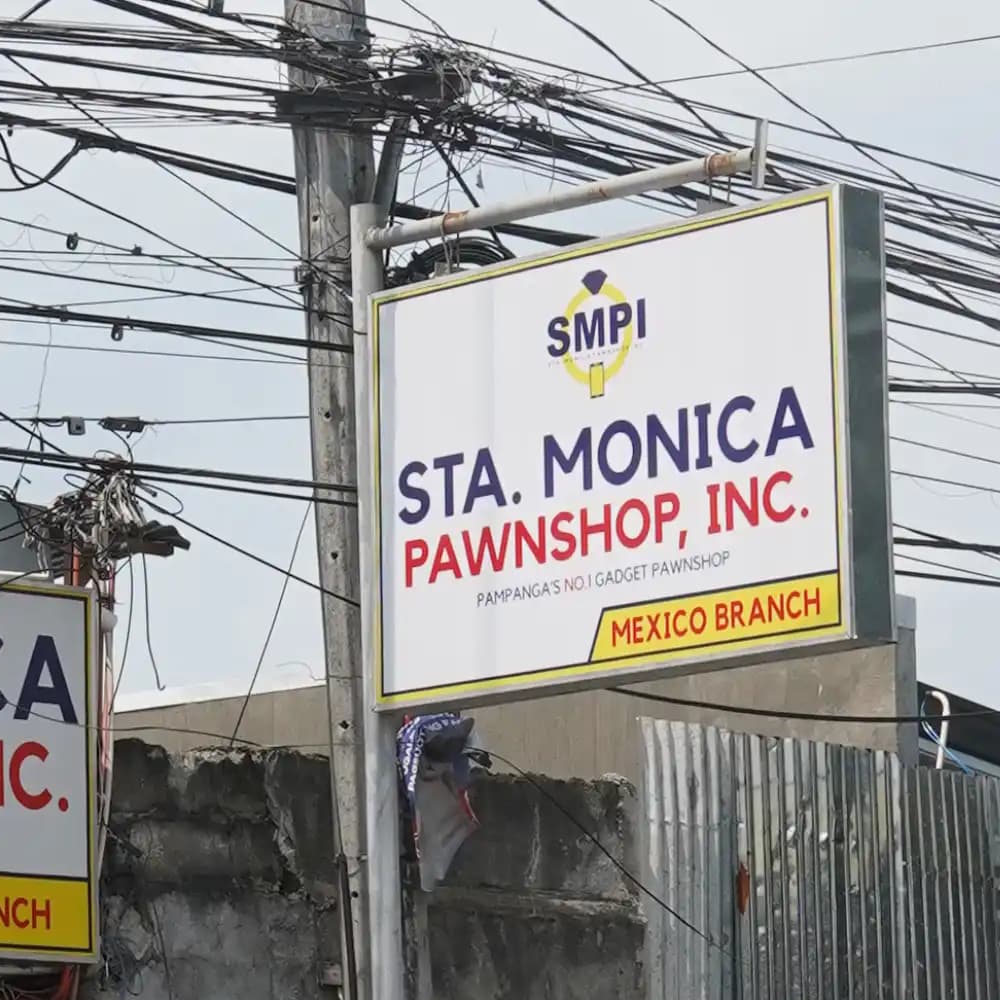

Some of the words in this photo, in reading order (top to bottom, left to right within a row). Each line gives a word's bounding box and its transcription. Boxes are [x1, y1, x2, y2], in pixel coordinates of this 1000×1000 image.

[547, 298, 646, 357] SMPI
[398, 447, 522, 525] STA.
[543, 386, 815, 497] MONICA
[404, 492, 687, 588] PAWNSHOP,
[707, 471, 809, 534] INC.
[476, 580, 560, 607] PAMPANGA'S
[595, 564, 648, 588] GADGET
[652, 551, 730, 579] PAWNSHOP
[611, 607, 706, 647] MEXICO
[714, 587, 821, 632] BRANCH
